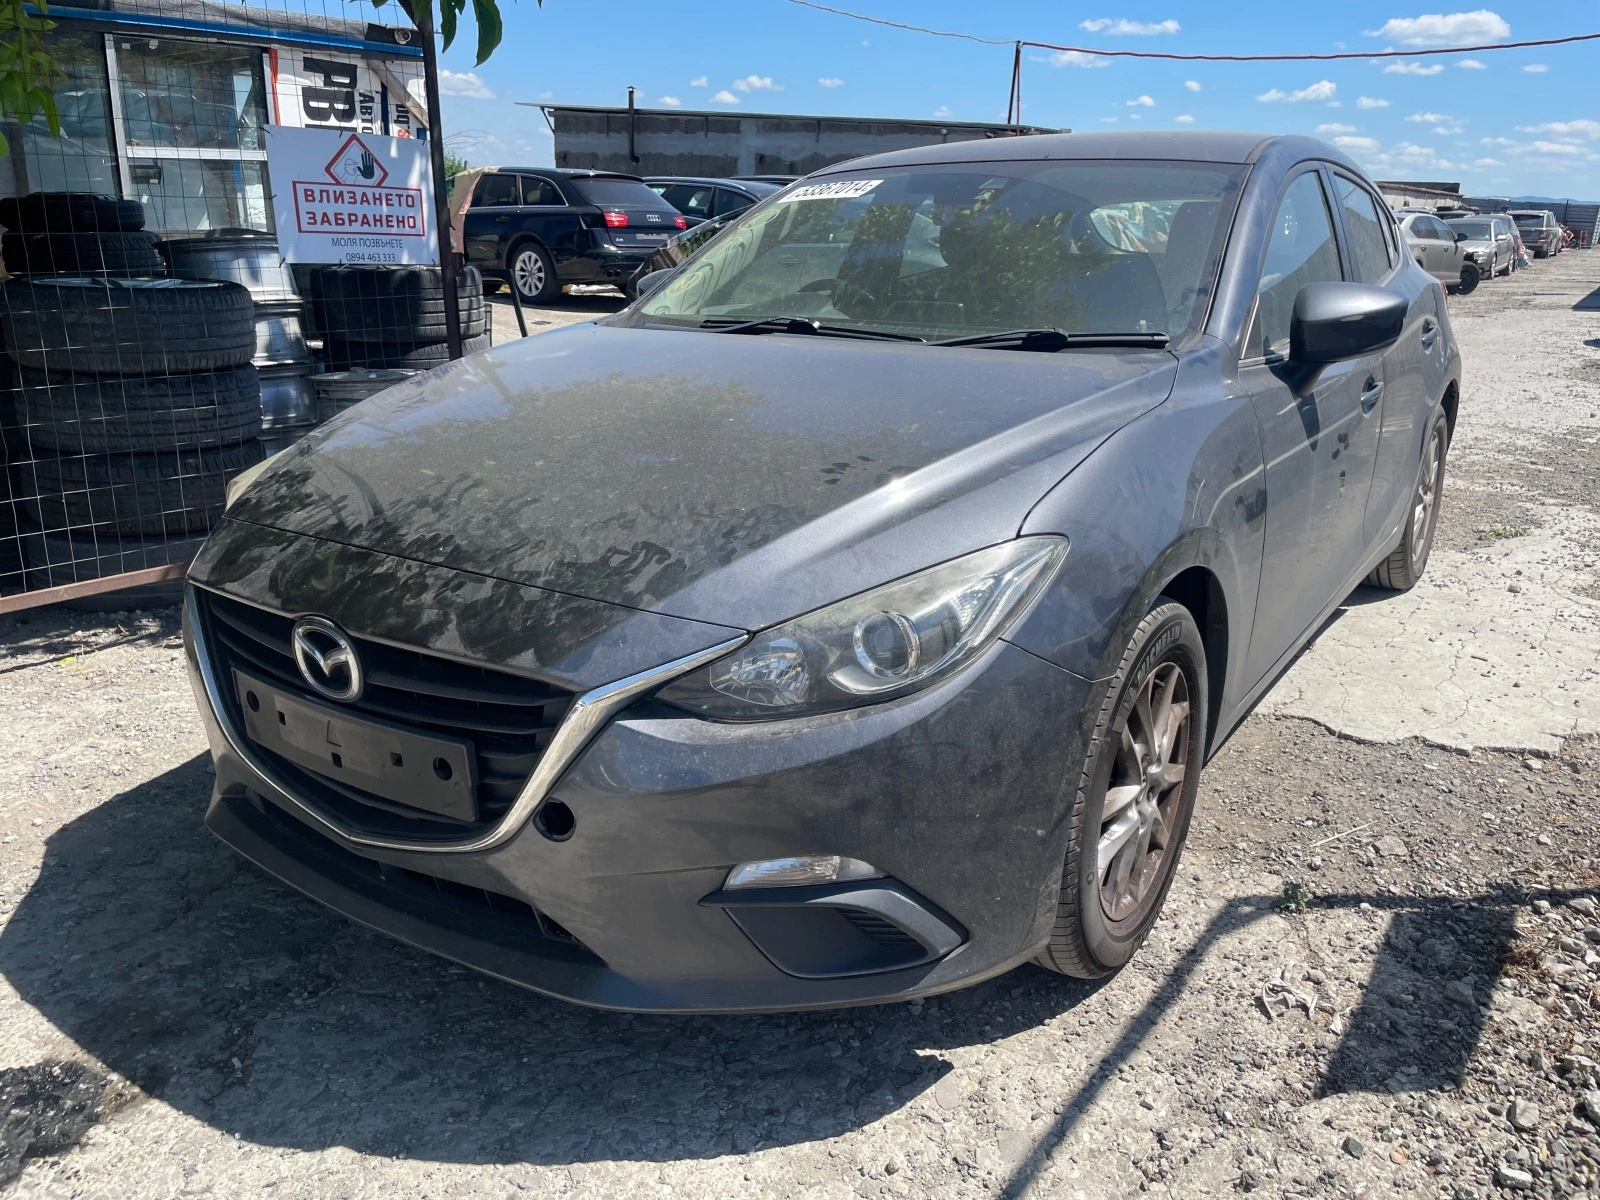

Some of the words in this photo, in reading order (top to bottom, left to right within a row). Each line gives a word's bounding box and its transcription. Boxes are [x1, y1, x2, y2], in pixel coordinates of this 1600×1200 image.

[304, 188, 416, 208] ВЛИЗАНЕТО
[306, 211, 417, 230] ЗАБРАНЕНО
[331, 237, 357, 248] МОЛЯ
[359, 238, 403, 249] ПОЗВЪНЕТЕ
[345, 252, 366, 262] 0894
[367, 253, 381, 262] 463
[382, 253, 396, 263] 333
